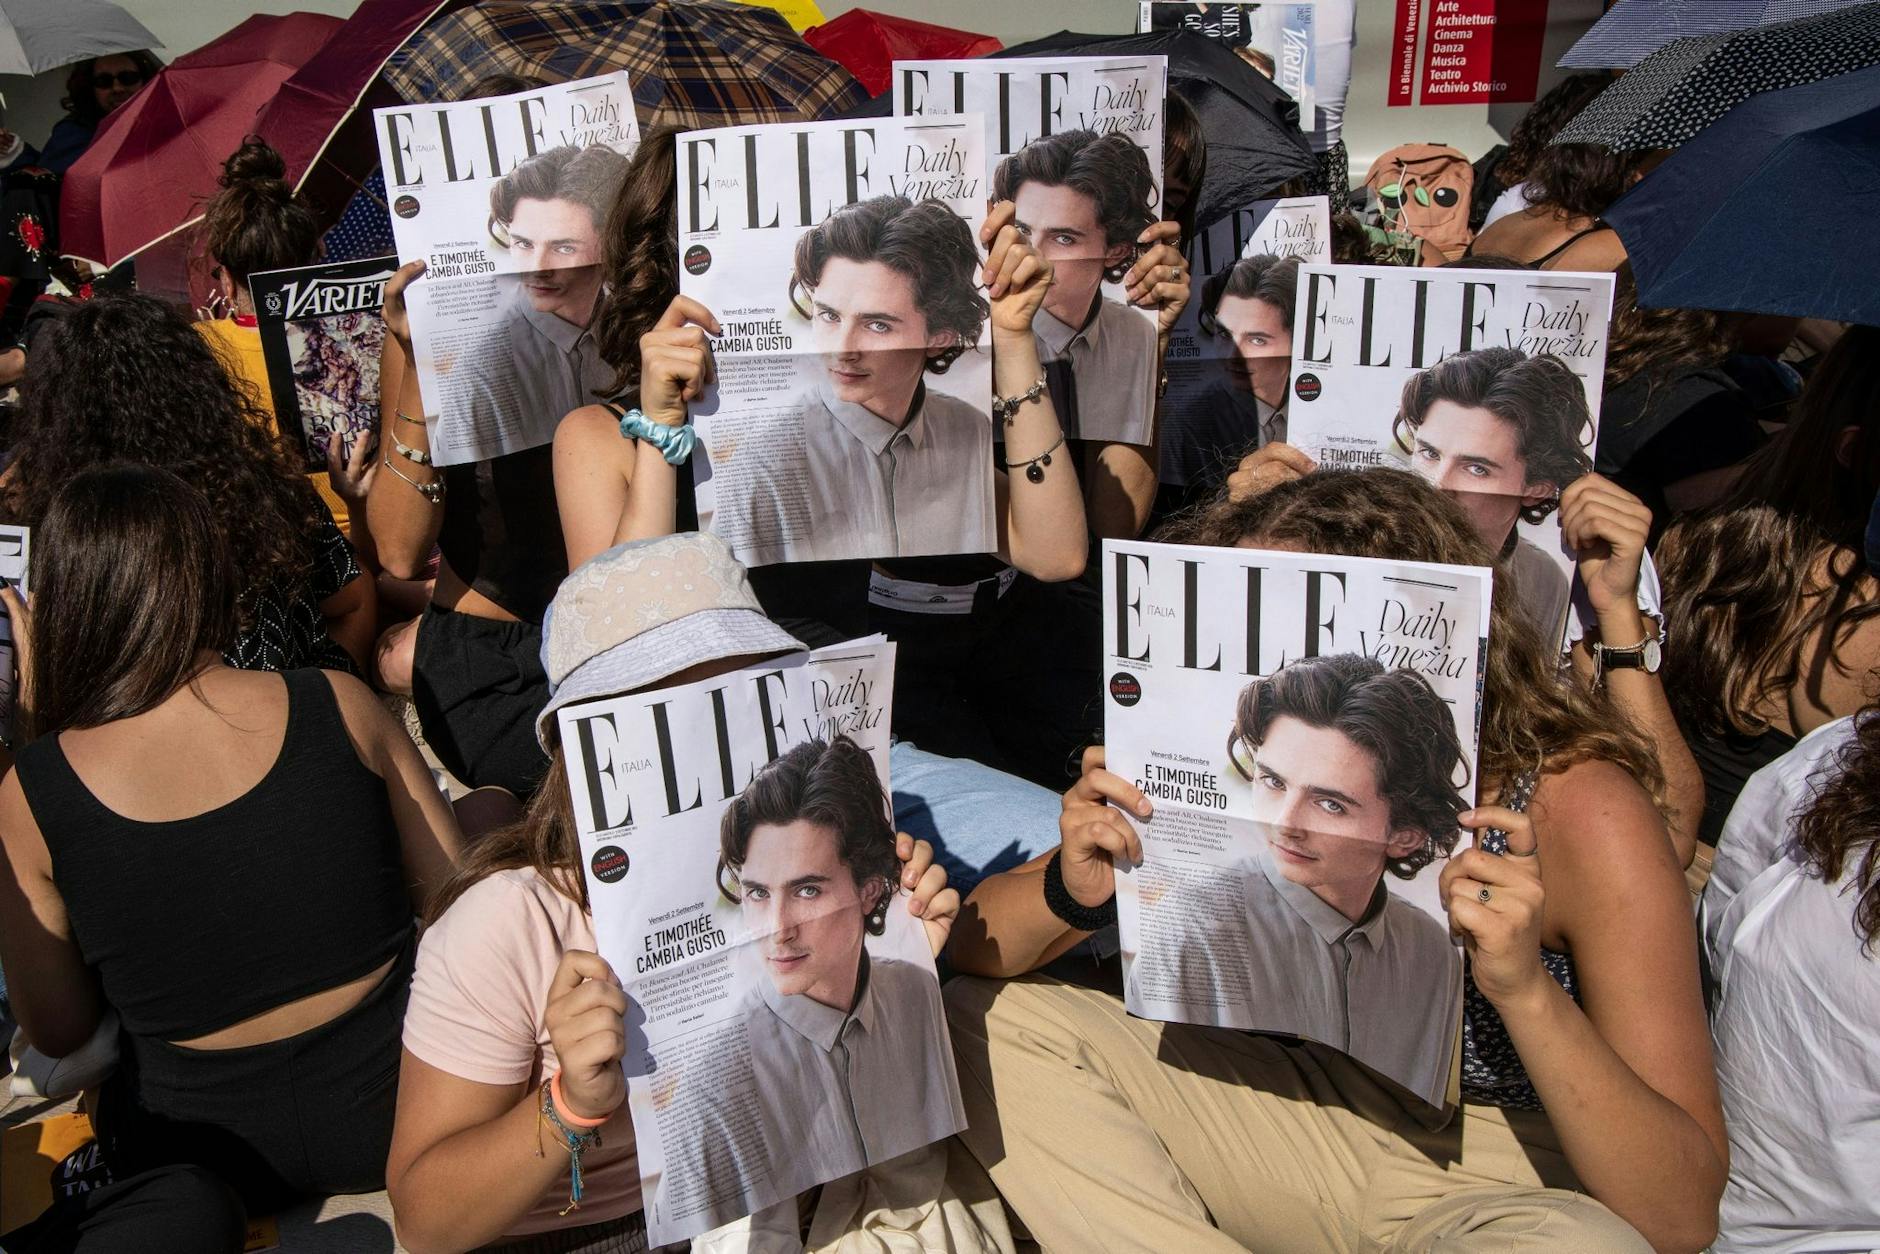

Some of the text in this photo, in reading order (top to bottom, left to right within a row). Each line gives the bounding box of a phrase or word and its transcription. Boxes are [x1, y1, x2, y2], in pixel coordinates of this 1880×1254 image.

[1436, 2, 1459, 13] Arte
[1435, 14, 1496, 27] Architettura
[1404, 34, 1415, 43] di
[1434, 29, 1473, 40] Cinema
[1433, 43, 1464, 54] Danza
[1401, 45, 1414, 84] Biennale
[1431, 57, 1467, 67] Musica
[1430, 69, 1461, 81] Teatro
[1092, 78, 1148, 112] Daily
[1400, 86, 1409, 95] La
[1428, 81, 1507, 94] Archivio Storico
[571, 94, 621, 127] Daily
[1078, 111, 1155, 133] Venezia
[380, 96, 547, 187] ELLE
[560, 123, 632, 147] Venezia
[415, 144, 438, 153] ITALIA
[904, 138, 968, 177] Daily
[682, 128, 876, 234] ELLE
[714, 178, 740, 188] ITALIA
[889, 174, 979, 200] Venezia
[1274, 214, 1317, 241] Daily
[430, 248, 486, 266] E TIMOTHÉE
[1263, 238, 1325, 257] Venezia
[425, 261, 496, 280] CAMBIA GUSTO
[280, 270, 398, 320] VARIET
[727, 318, 782, 337] TIMOTHÉE
[1297, 272, 1496, 370] ELLE
[1331, 315, 1354, 326] ITALIA
[1522, 300, 1591, 337] Daily
[709, 336, 792, 353] CAMBIA GUSTO
[1505, 327, 1599, 358] Venezia
[1176, 347, 1200, 358] GUSTO
[1321, 448, 1383, 465] E TIMOTHÉE
[1109, 550, 1347, 677] ELLE
[1147, 604, 1176, 618] ITALIA
[1379, 599, 1456, 648] Daily
[1359, 630, 1468, 680] Venezia
[811, 668, 876, 713] Daily
[801, 704, 884, 743] Venezia
[568, 669, 789, 834] ELLE
[1179, 754, 1210, 766] Settembre
[621, 758, 653, 776] ITALIA
[1145, 764, 1217, 791] E TIMOTHÉE
[1135, 779, 1227, 810] CAMBIA GUSTO
[593, 855, 625, 873] ENGLISH
[600, 852, 615, 861] WITH
[600, 865, 626, 878] VERSION
[676, 901, 704, 916] Settembre
[644, 913, 713, 952] E TIMOTHÉE
[637, 929, 726, 974] CAMBIA GUSTO
